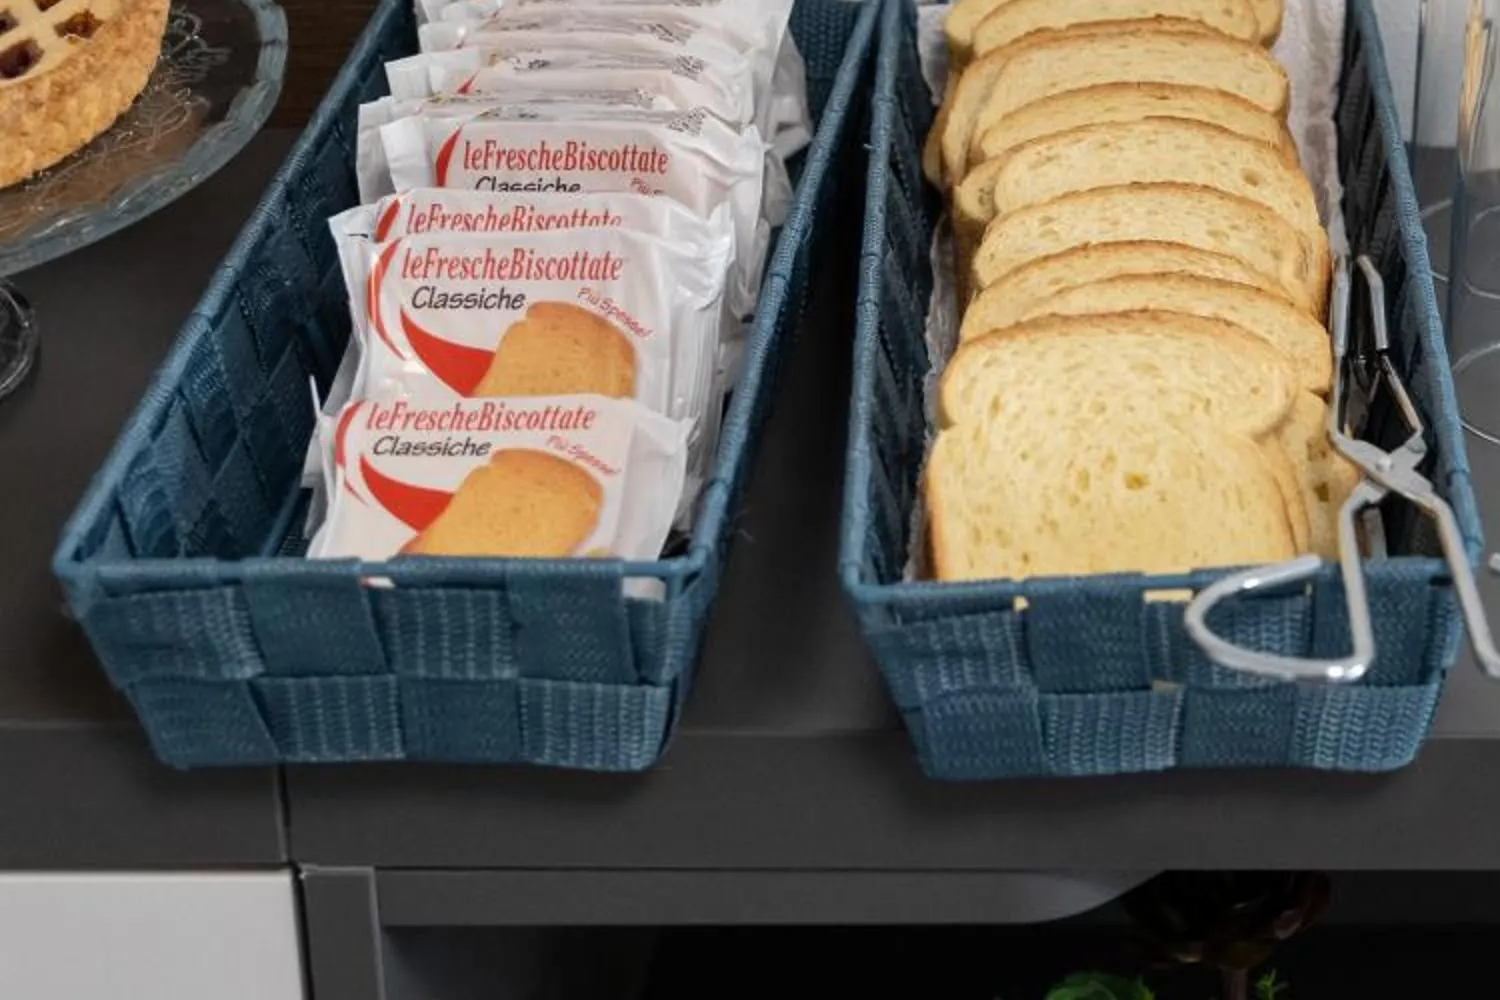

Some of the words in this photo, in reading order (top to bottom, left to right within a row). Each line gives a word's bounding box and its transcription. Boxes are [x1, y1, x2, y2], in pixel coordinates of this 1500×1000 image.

[463, 139, 670, 174] leFrescheBiscottate
[401, 247, 623, 281] leFrescheBiscottate
[411, 285, 526, 310] Classiche
[366, 401, 596, 431] leFrescheBiscottate
[373, 435, 492, 457] Classiche
